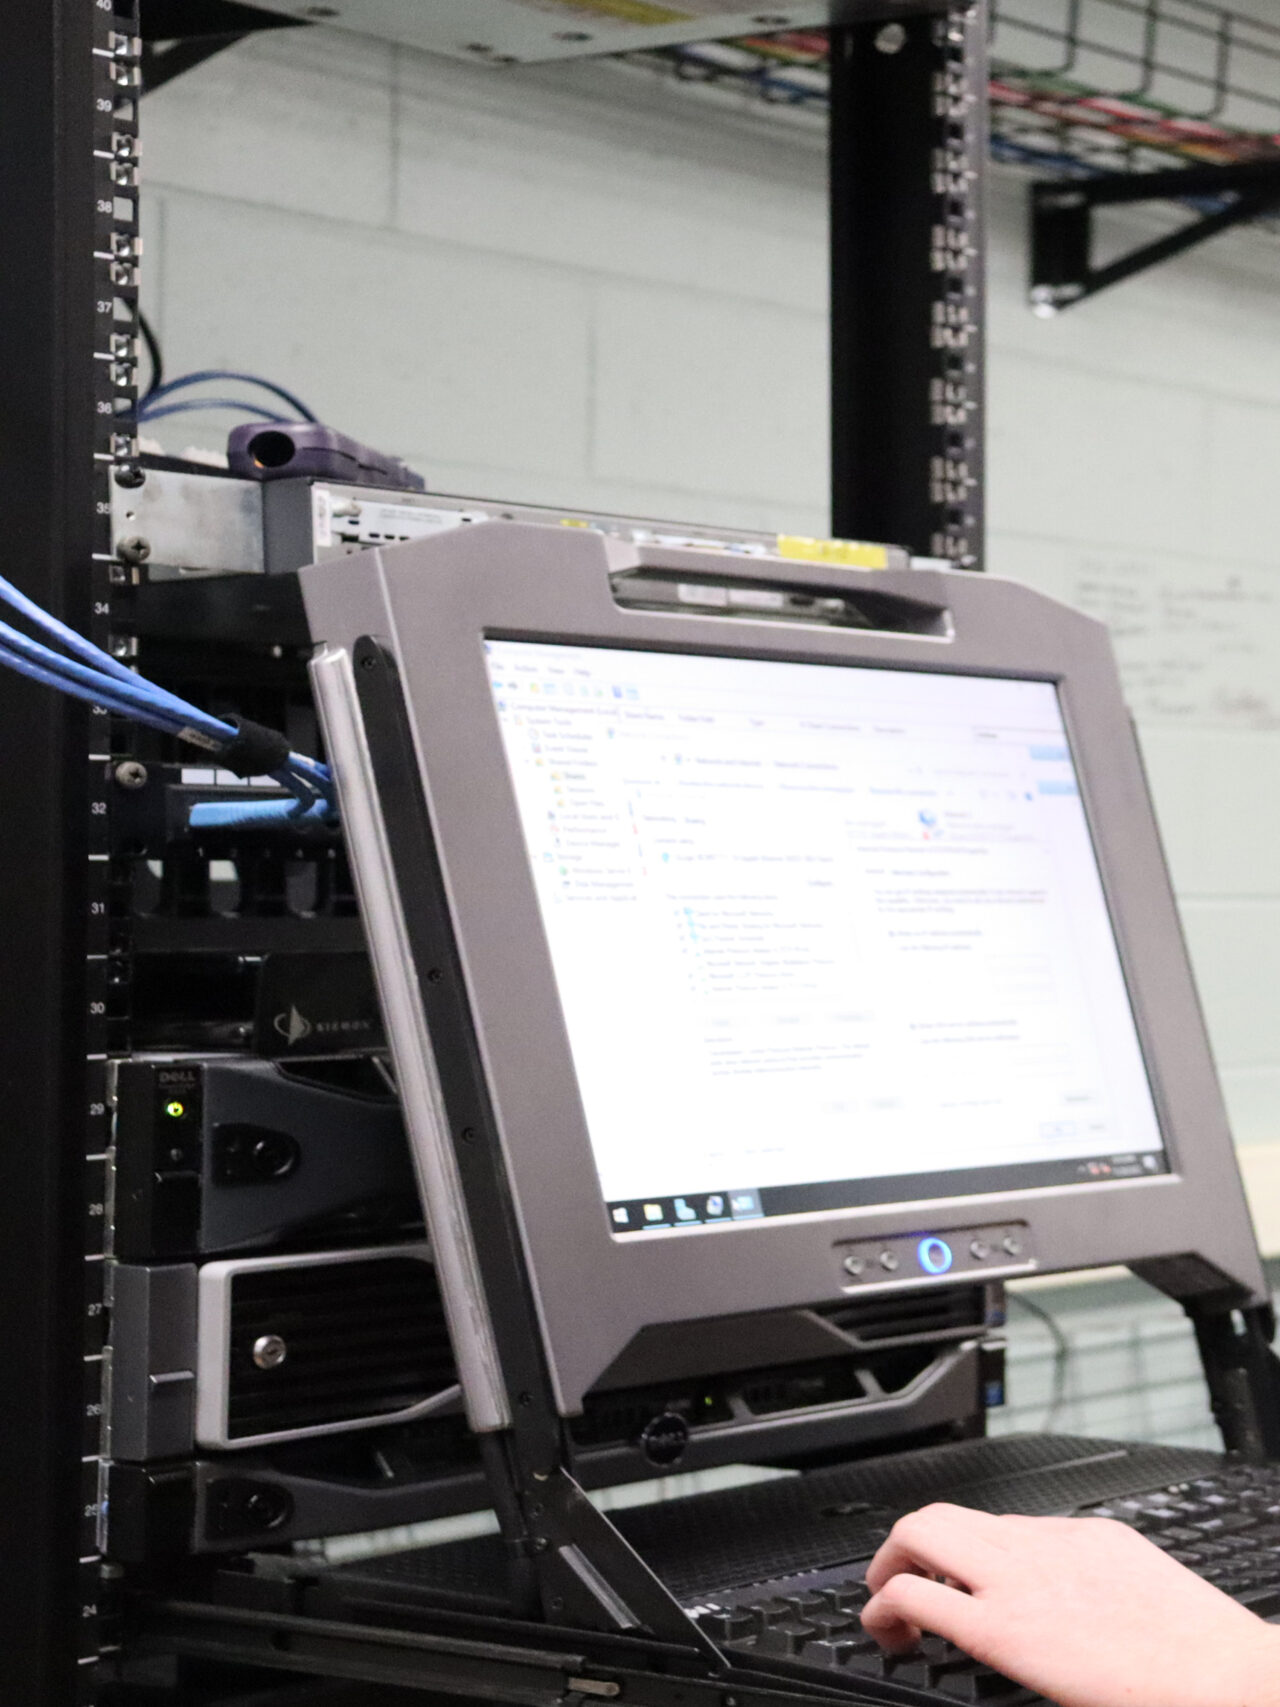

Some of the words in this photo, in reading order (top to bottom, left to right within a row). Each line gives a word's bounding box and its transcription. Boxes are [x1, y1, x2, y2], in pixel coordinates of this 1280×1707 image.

[96, 98, 112, 112] 39
[96, 200, 112, 214] 38
[97, 300, 113, 313] 37
[94, 602, 109, 615] 34
[91, 801, 106, 815] 32
[91, 901, 105, 914] 31
[90, 1001, 105, 1015] 30
[90, 1103, 105, 1116] 29
[87, 1303, 102, 1317] 27
[82, 1604, 97, 1618] 24
